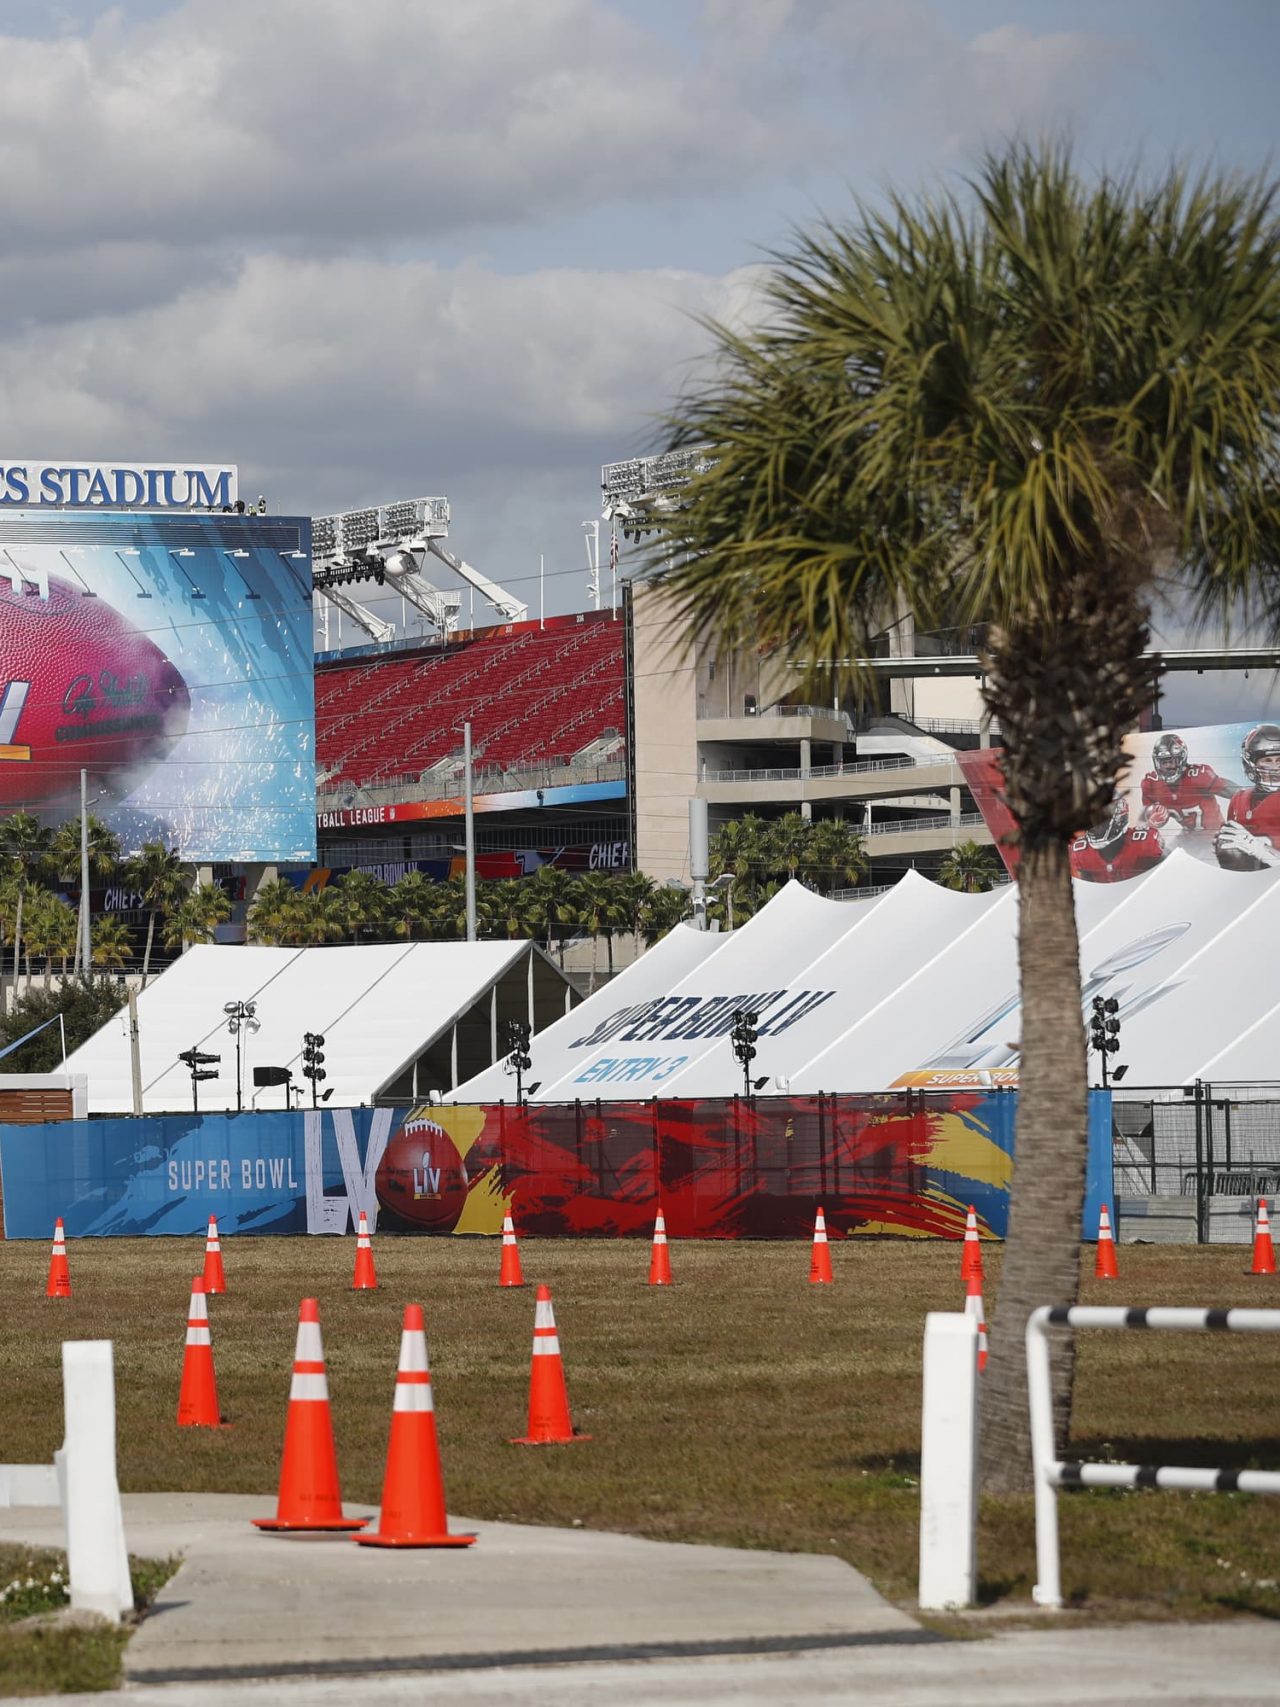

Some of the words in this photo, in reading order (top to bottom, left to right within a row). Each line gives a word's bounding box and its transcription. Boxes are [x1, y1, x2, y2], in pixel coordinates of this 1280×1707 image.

[40, 467, 233, 507] STADIUM
[317, 811, 345, 829] TBALL
[350, 807, 385, 825] LEAGUE
[589, 842, 628, 869] CHIEF
[104, 888, 145, 911] CHIEFS
[568, 996, 703, 1049] SUPER
[756, 990, 837, 1036] LV
[573, 1056, 672, 1083] ENTRY
[652, 1056, 689, 1081] 3
[168, 1159, 232, 1191] SUPER
[242, 1158, 298, 1190] BOWL
[304, 1108, 394, 1235] LV
